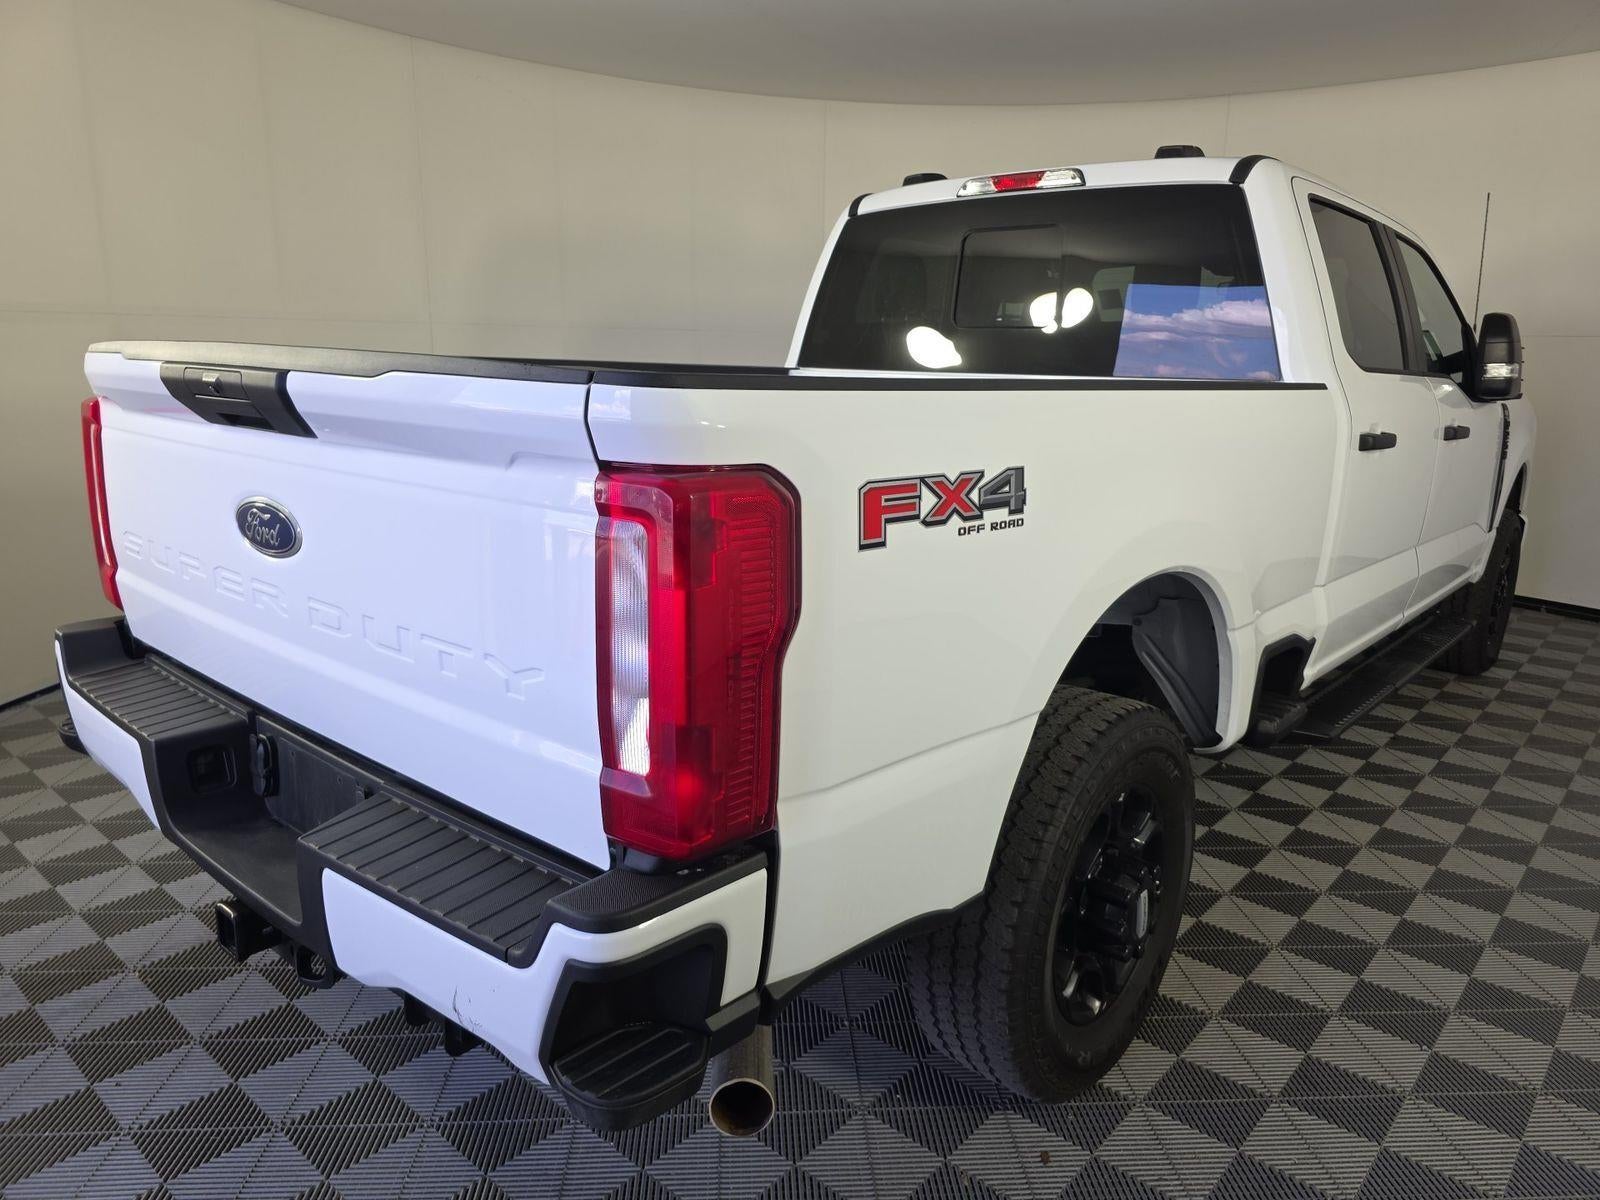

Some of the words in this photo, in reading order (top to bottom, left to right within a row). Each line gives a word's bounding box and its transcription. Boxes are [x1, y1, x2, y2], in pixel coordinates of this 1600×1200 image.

[244, 508, 282, 547] Ford
[857, 465, 1027, 552] FX4
[957, 524, 986, 537] OFF
[989, 517, 1025, 532] ROAD
[122, 529, 288, 618] SUPER
[307, 596, 546, 701] DUTY
